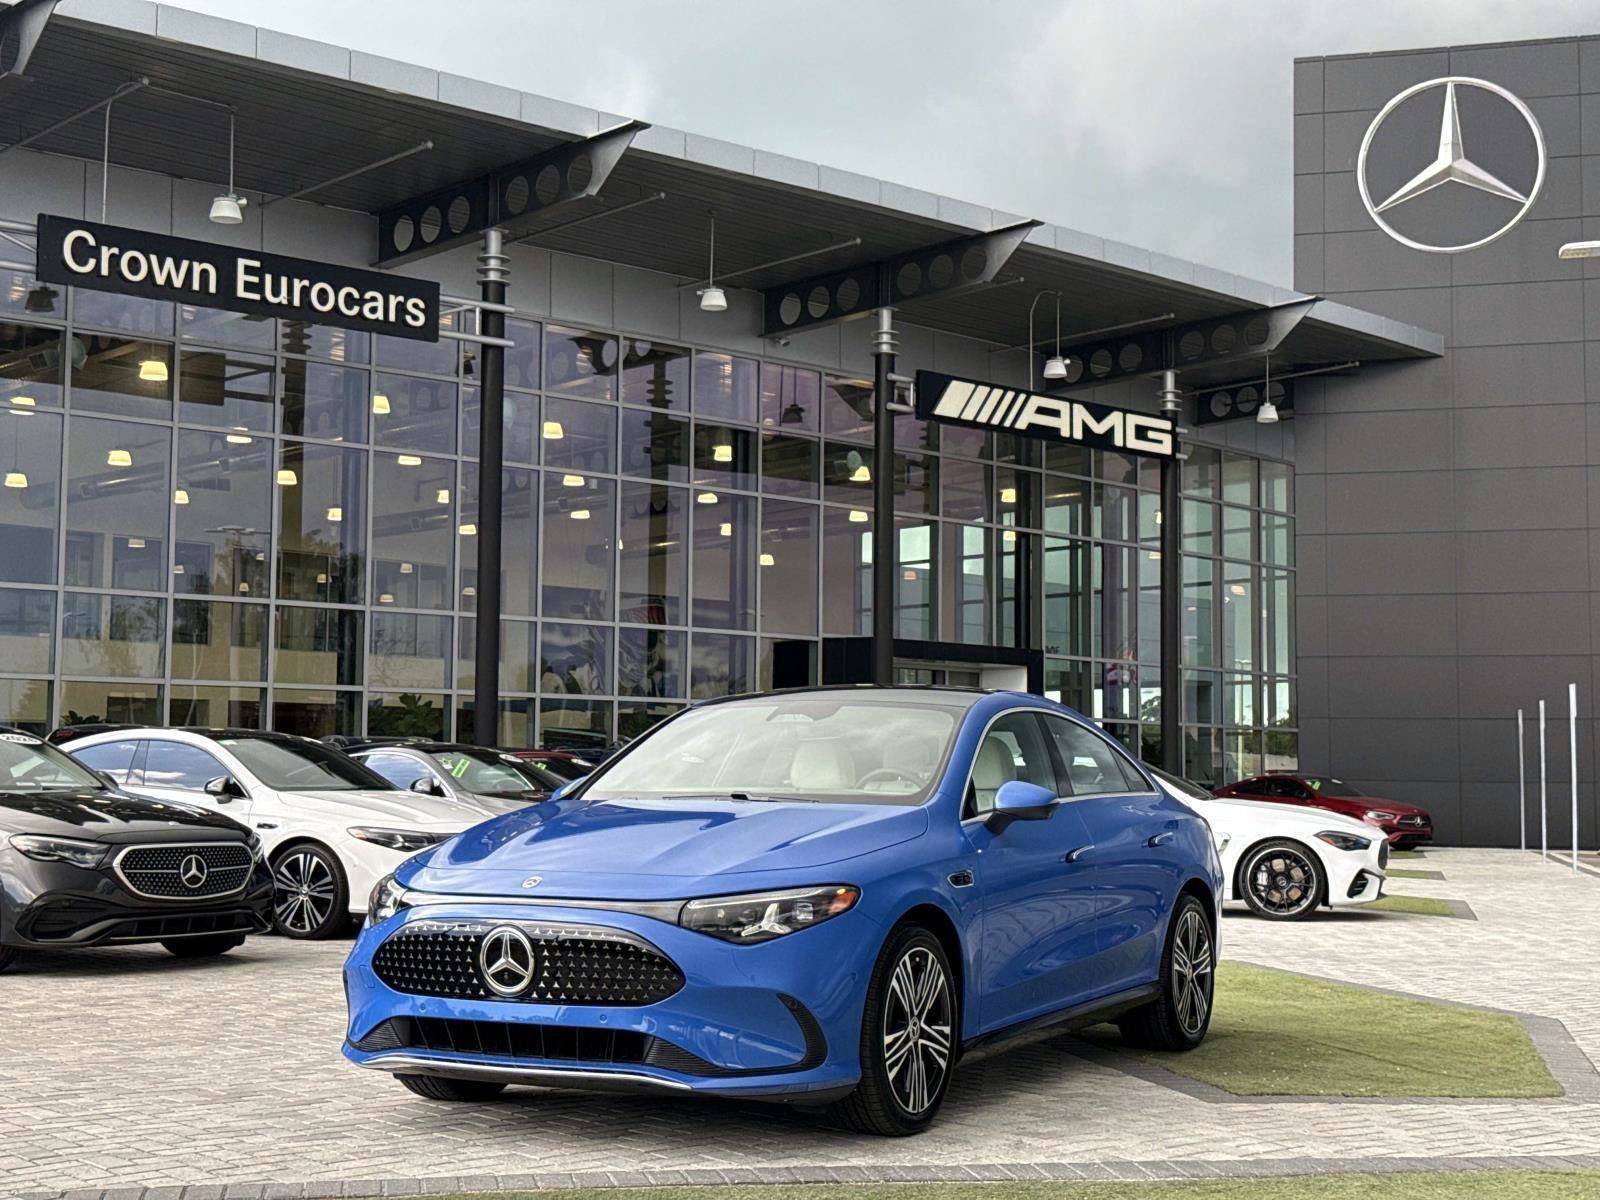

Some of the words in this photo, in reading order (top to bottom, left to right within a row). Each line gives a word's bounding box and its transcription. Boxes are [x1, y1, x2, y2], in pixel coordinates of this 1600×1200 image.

[63, 229, 217, 294] Crown
[236, 257, 427, 327] Eurocars
[1014, 395, 1172, 455] AMG
